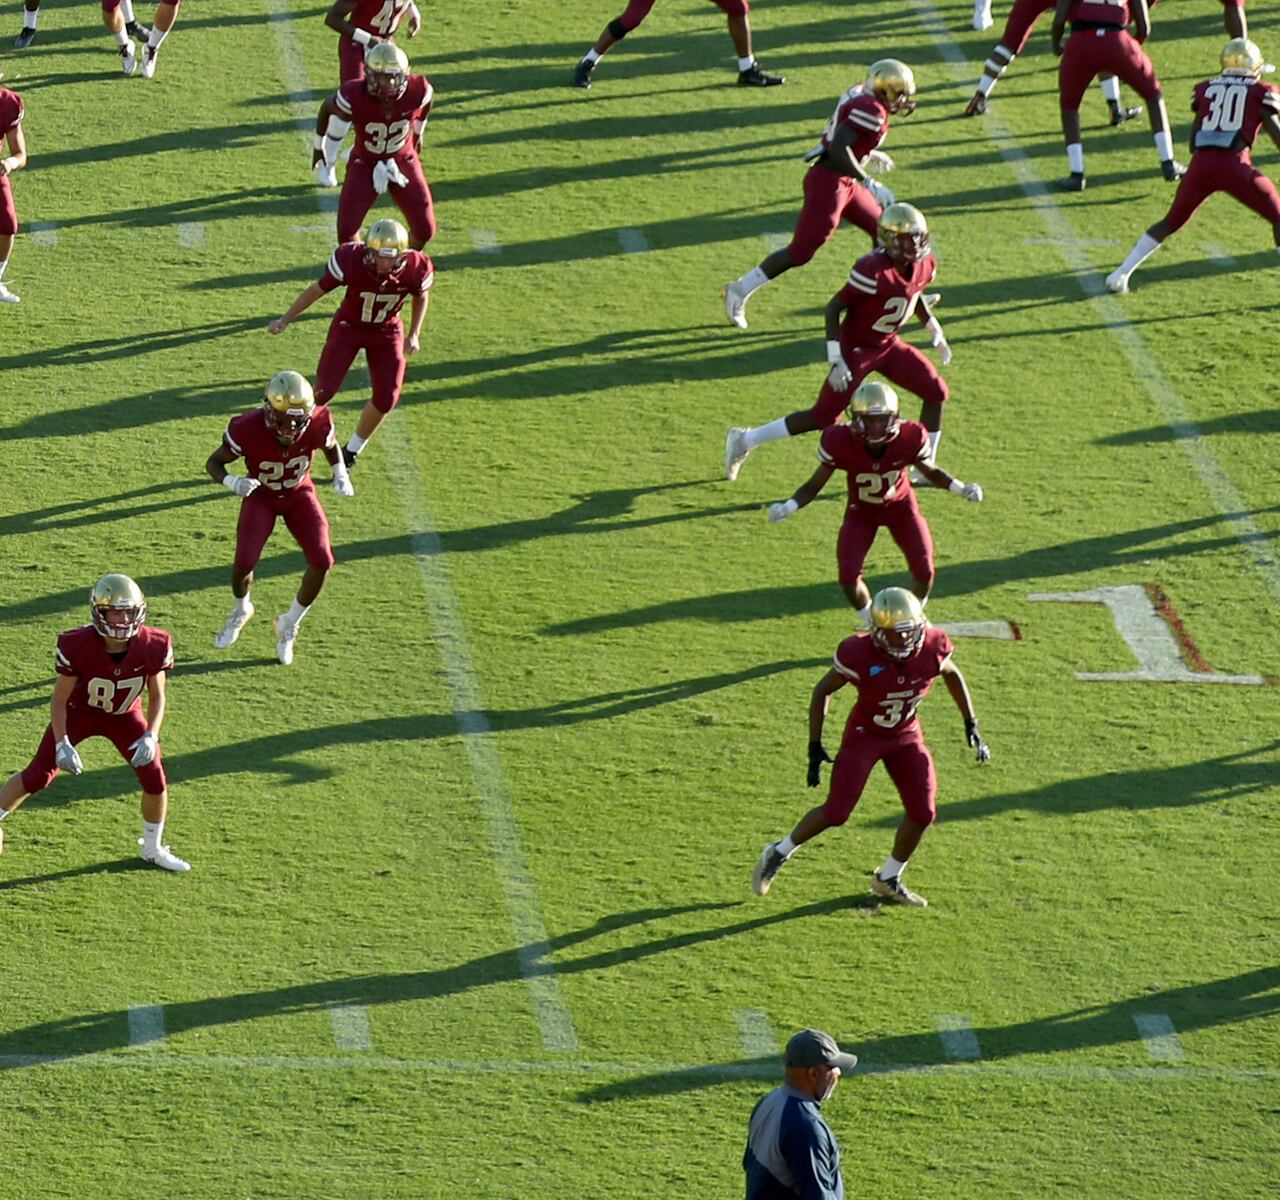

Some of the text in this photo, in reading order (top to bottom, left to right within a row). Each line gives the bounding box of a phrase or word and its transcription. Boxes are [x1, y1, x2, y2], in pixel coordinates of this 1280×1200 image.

[1201, 83, 1248, 132] 30
[363, 119, 410, 155] 32
[359, 291, 402, 323] 17
[258, 455, 309, 491] 23
[1026, 583, 1278, 687] 1
[87, 676, 144, 716] 87
